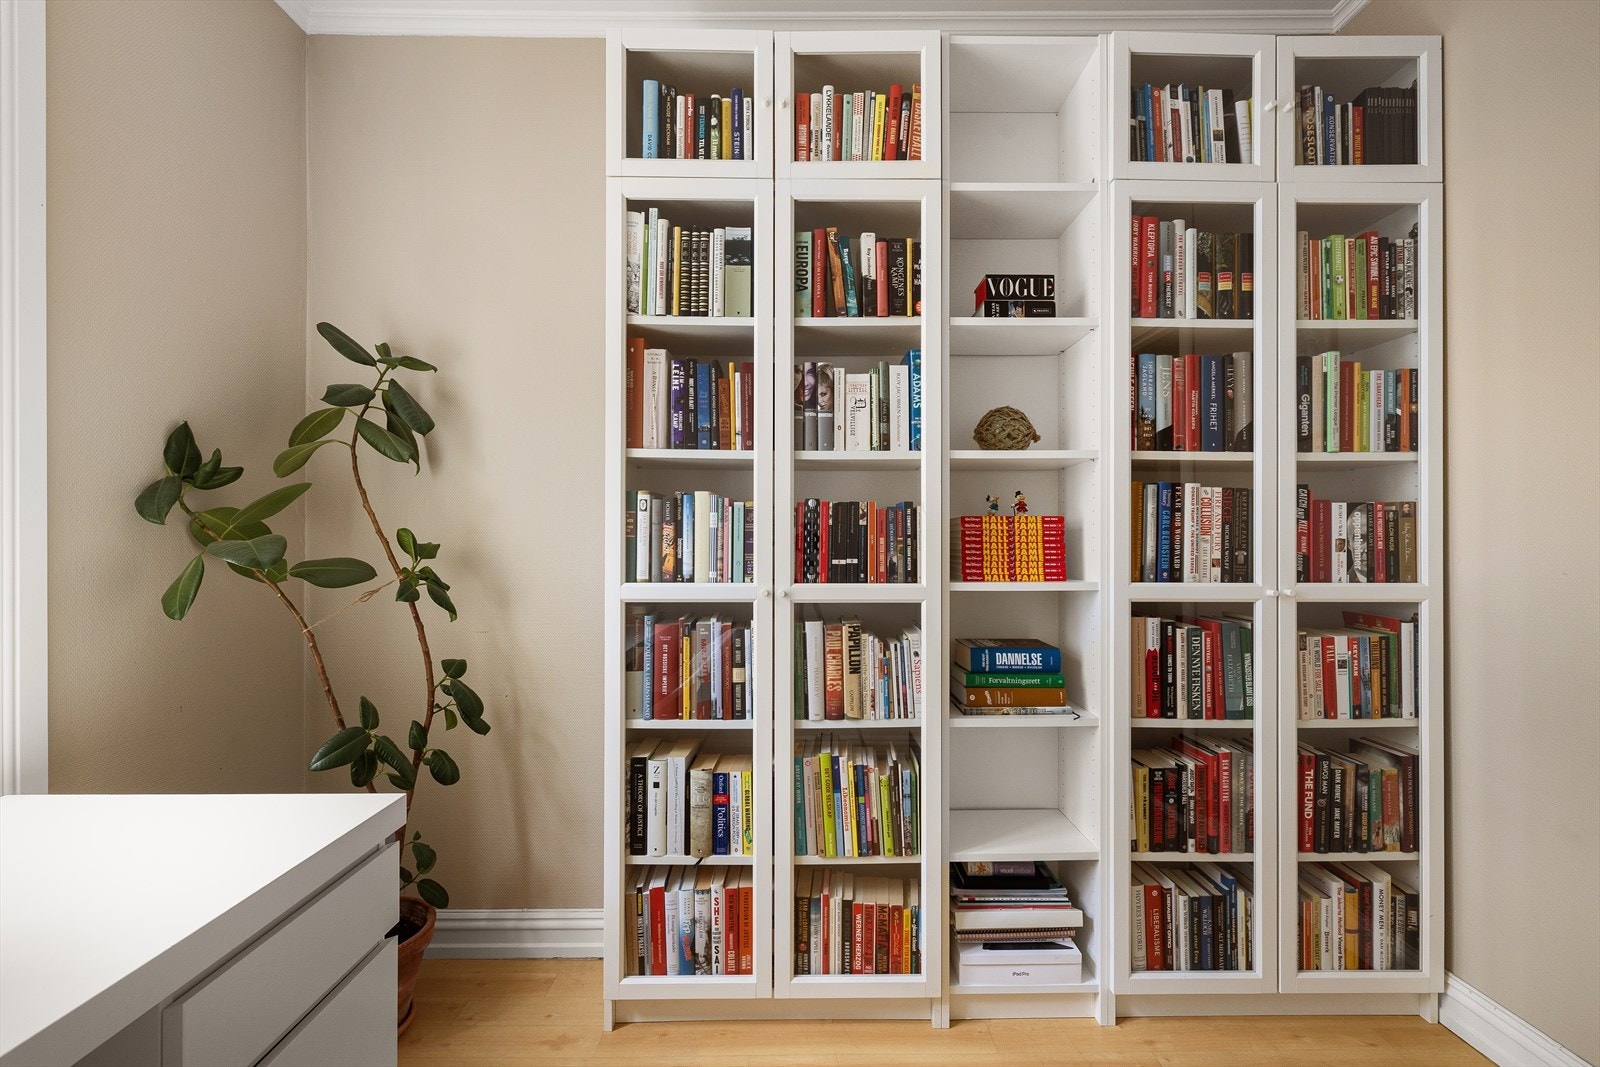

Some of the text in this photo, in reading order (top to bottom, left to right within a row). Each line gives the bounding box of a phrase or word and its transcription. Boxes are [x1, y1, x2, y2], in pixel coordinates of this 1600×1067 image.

[911, 102, 921, 157] BASKETBALL
[1147, 223, 1155, 257] KLEPTOPIA
[1370, 236, 1378, 244] AN
[796, 245, 808, 292] EUROPA
[896, 257, 904, 297] KONGENES
[987, 278, 1054, 297] VOGUE
[912, 373, 921, 408] ADAMS
[1160, 366, 1171, 397] JENS
[1299, 394, 1310, 436] Giganten
[1223, 489, 1232, 522] SIEGE
[1298, 488, 1308, 508] CATCH
[1200, 497, 1211, 536] COLLUSION
[1298, 520, 1308, 533] KILL
[1161, 510, 1170, 569] CARL BERNSTEIN
[1354, 511, 1363, 570] oppenheimer
[827, 630, 842, 692] PAUL CHARLES
[848, 625, 861, 674] PAPILLON
[996, 652, 1043, 666] DANNELSE
[1326, 645, 1335, 664] FALL
[1371, 640, 1379, 670] TRILLIONS
[912, 659, 922, 695] Sapiens
[1191, 637, 1200, 711] DEN NYE FISKEN
[1305, 769, 1314, 819] THE FUND
[717, 807, 726, 838] Politics
[878, 905, 888, 949] McMAFIA
[1397, 899, 1405, 935] BLACK EDGE
